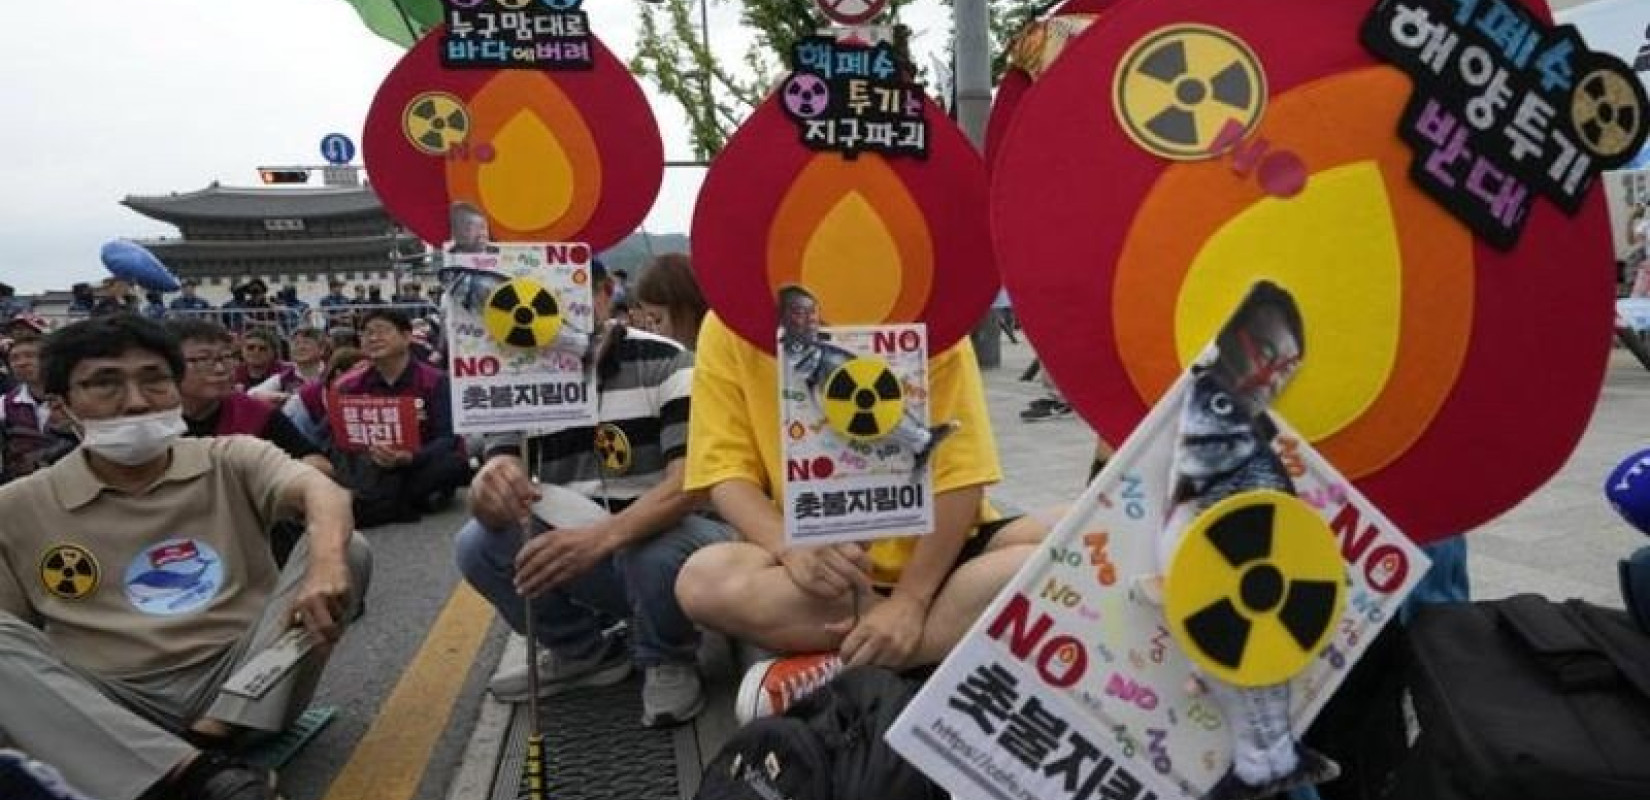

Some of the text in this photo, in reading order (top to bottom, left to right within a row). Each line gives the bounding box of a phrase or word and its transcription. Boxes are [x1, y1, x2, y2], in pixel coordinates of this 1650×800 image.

[805, 118, 925, 149] 지구파괴
[546, 245, 588, 264] NO
[874, 330, 919, 354] NO
[454, 356, 499, 377] NO
[787, 456, 834, 482] NO
[1330, 502, 1408, 593] NO
[987, 592, 1089, 688] NO
